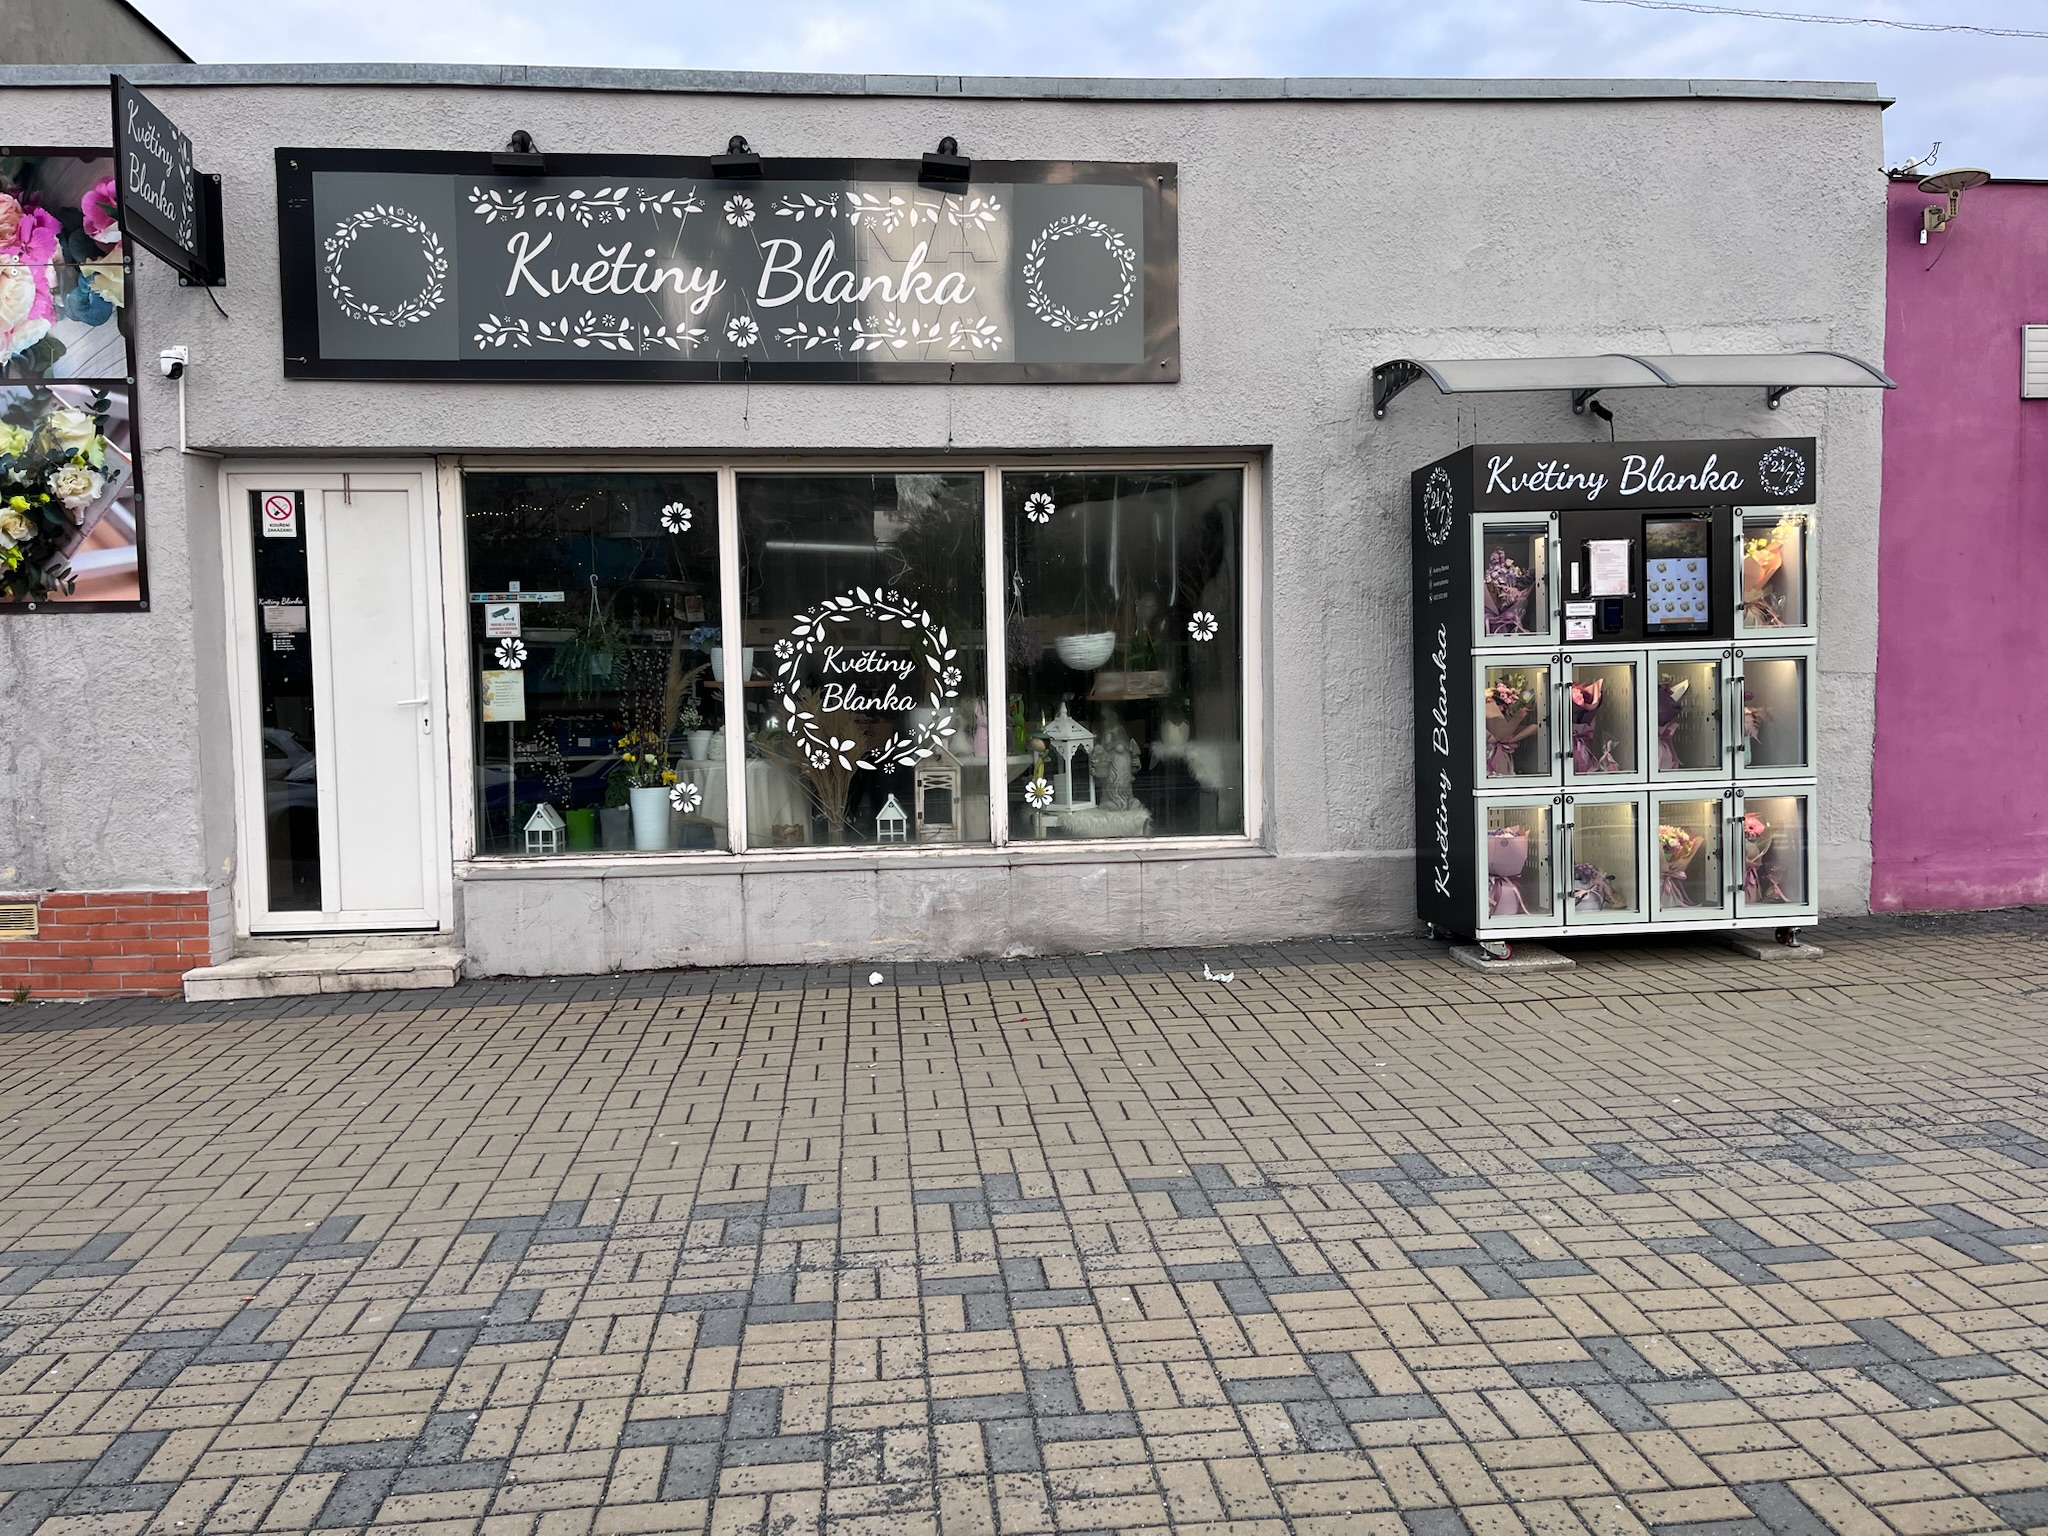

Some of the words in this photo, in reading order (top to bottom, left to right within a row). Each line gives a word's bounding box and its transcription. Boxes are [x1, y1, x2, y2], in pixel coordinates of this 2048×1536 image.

[127, 99, 174, 178] Květiny
[129, 152, 176, 222] Blanka
[505, 231, 727, 313] Květiny
[755, 238, 976, 308] Blanka
[1486, 455, 1608, 501] Květiny
[1619, 453, 1744, 495] Blanka
[821, 683, 917, 713] Blanka
[822, 646, 916, 680] Květiny
[1432, 623, 1449, 756] Blanka
[1434, 768, 1451, 897] Květiny
